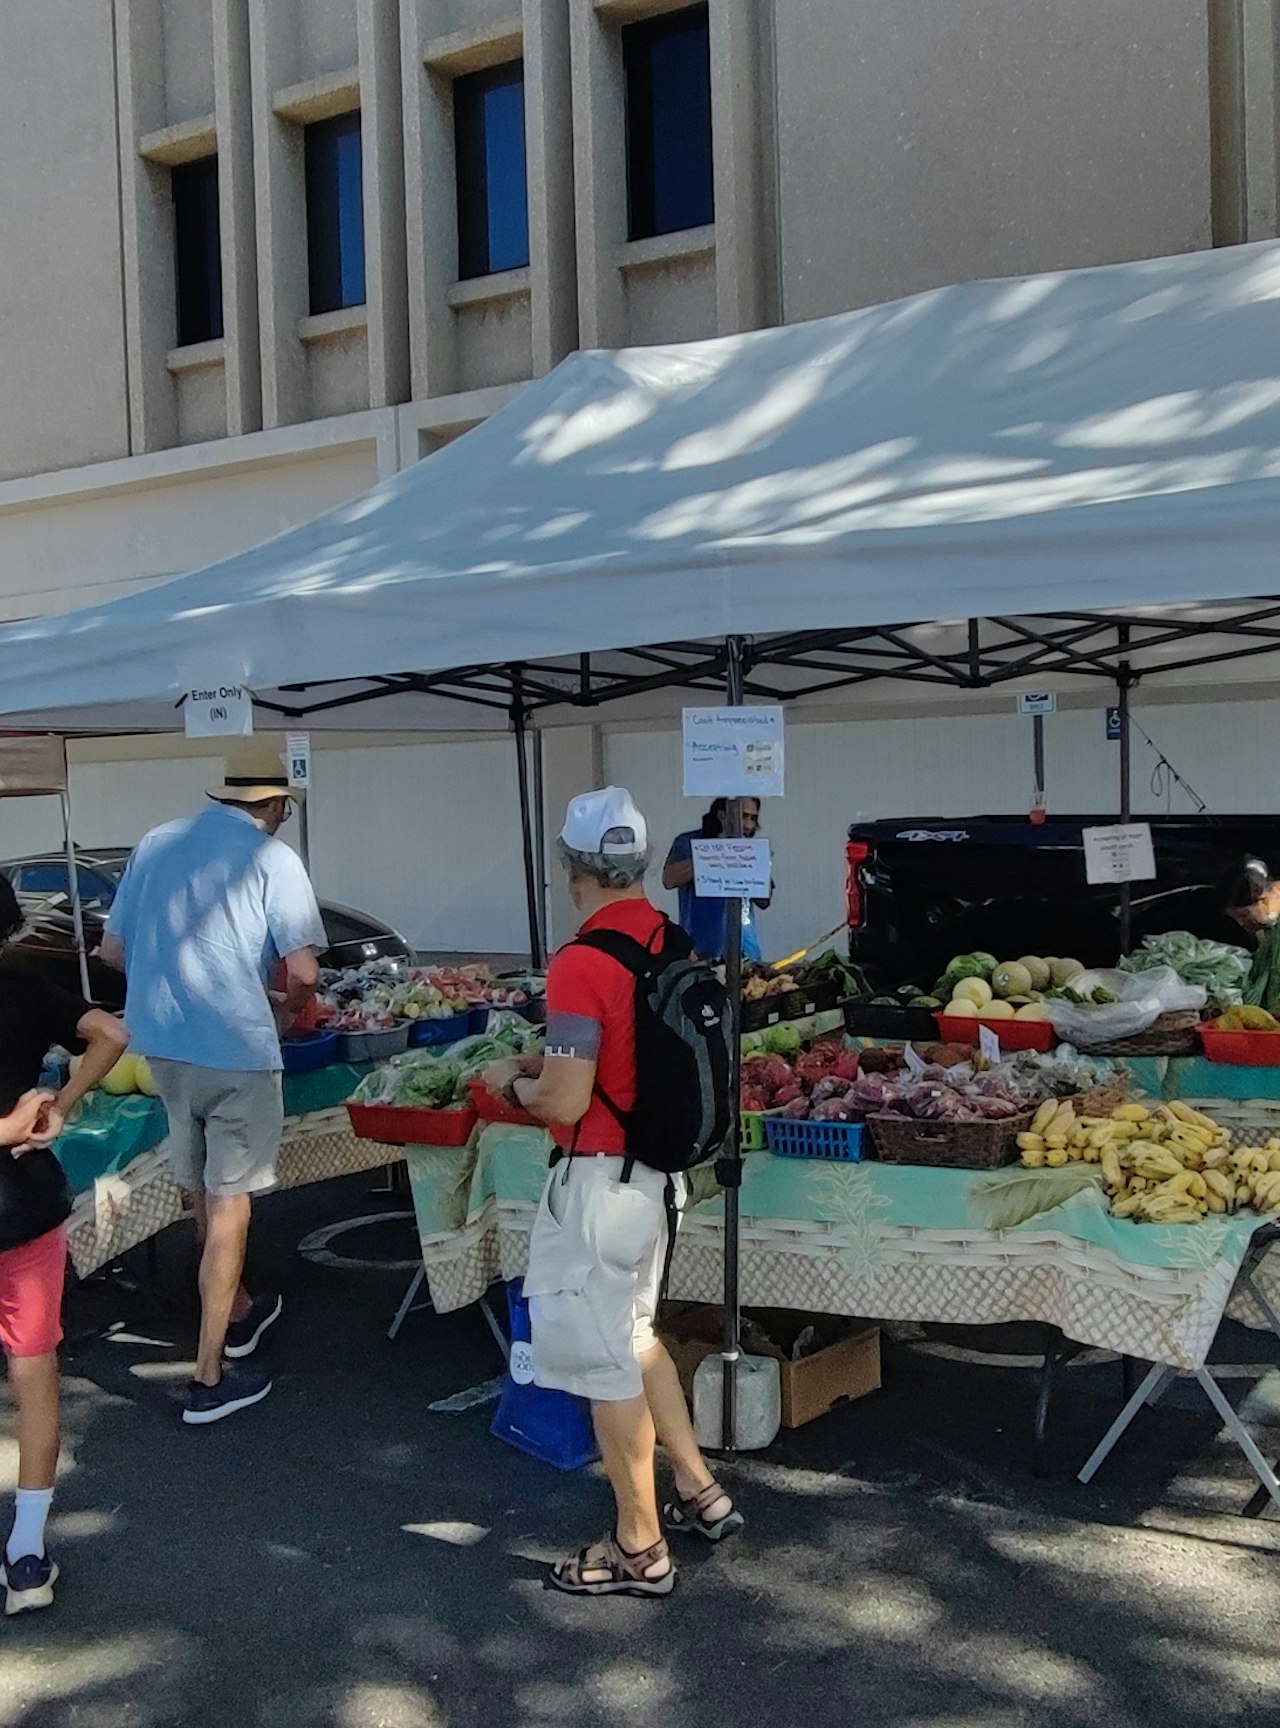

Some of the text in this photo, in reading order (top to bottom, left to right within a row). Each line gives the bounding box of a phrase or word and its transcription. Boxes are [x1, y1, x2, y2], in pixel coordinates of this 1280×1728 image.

[192, 687, 242, 701] Enter Only
[210, 707, 227, 721] (IN)
